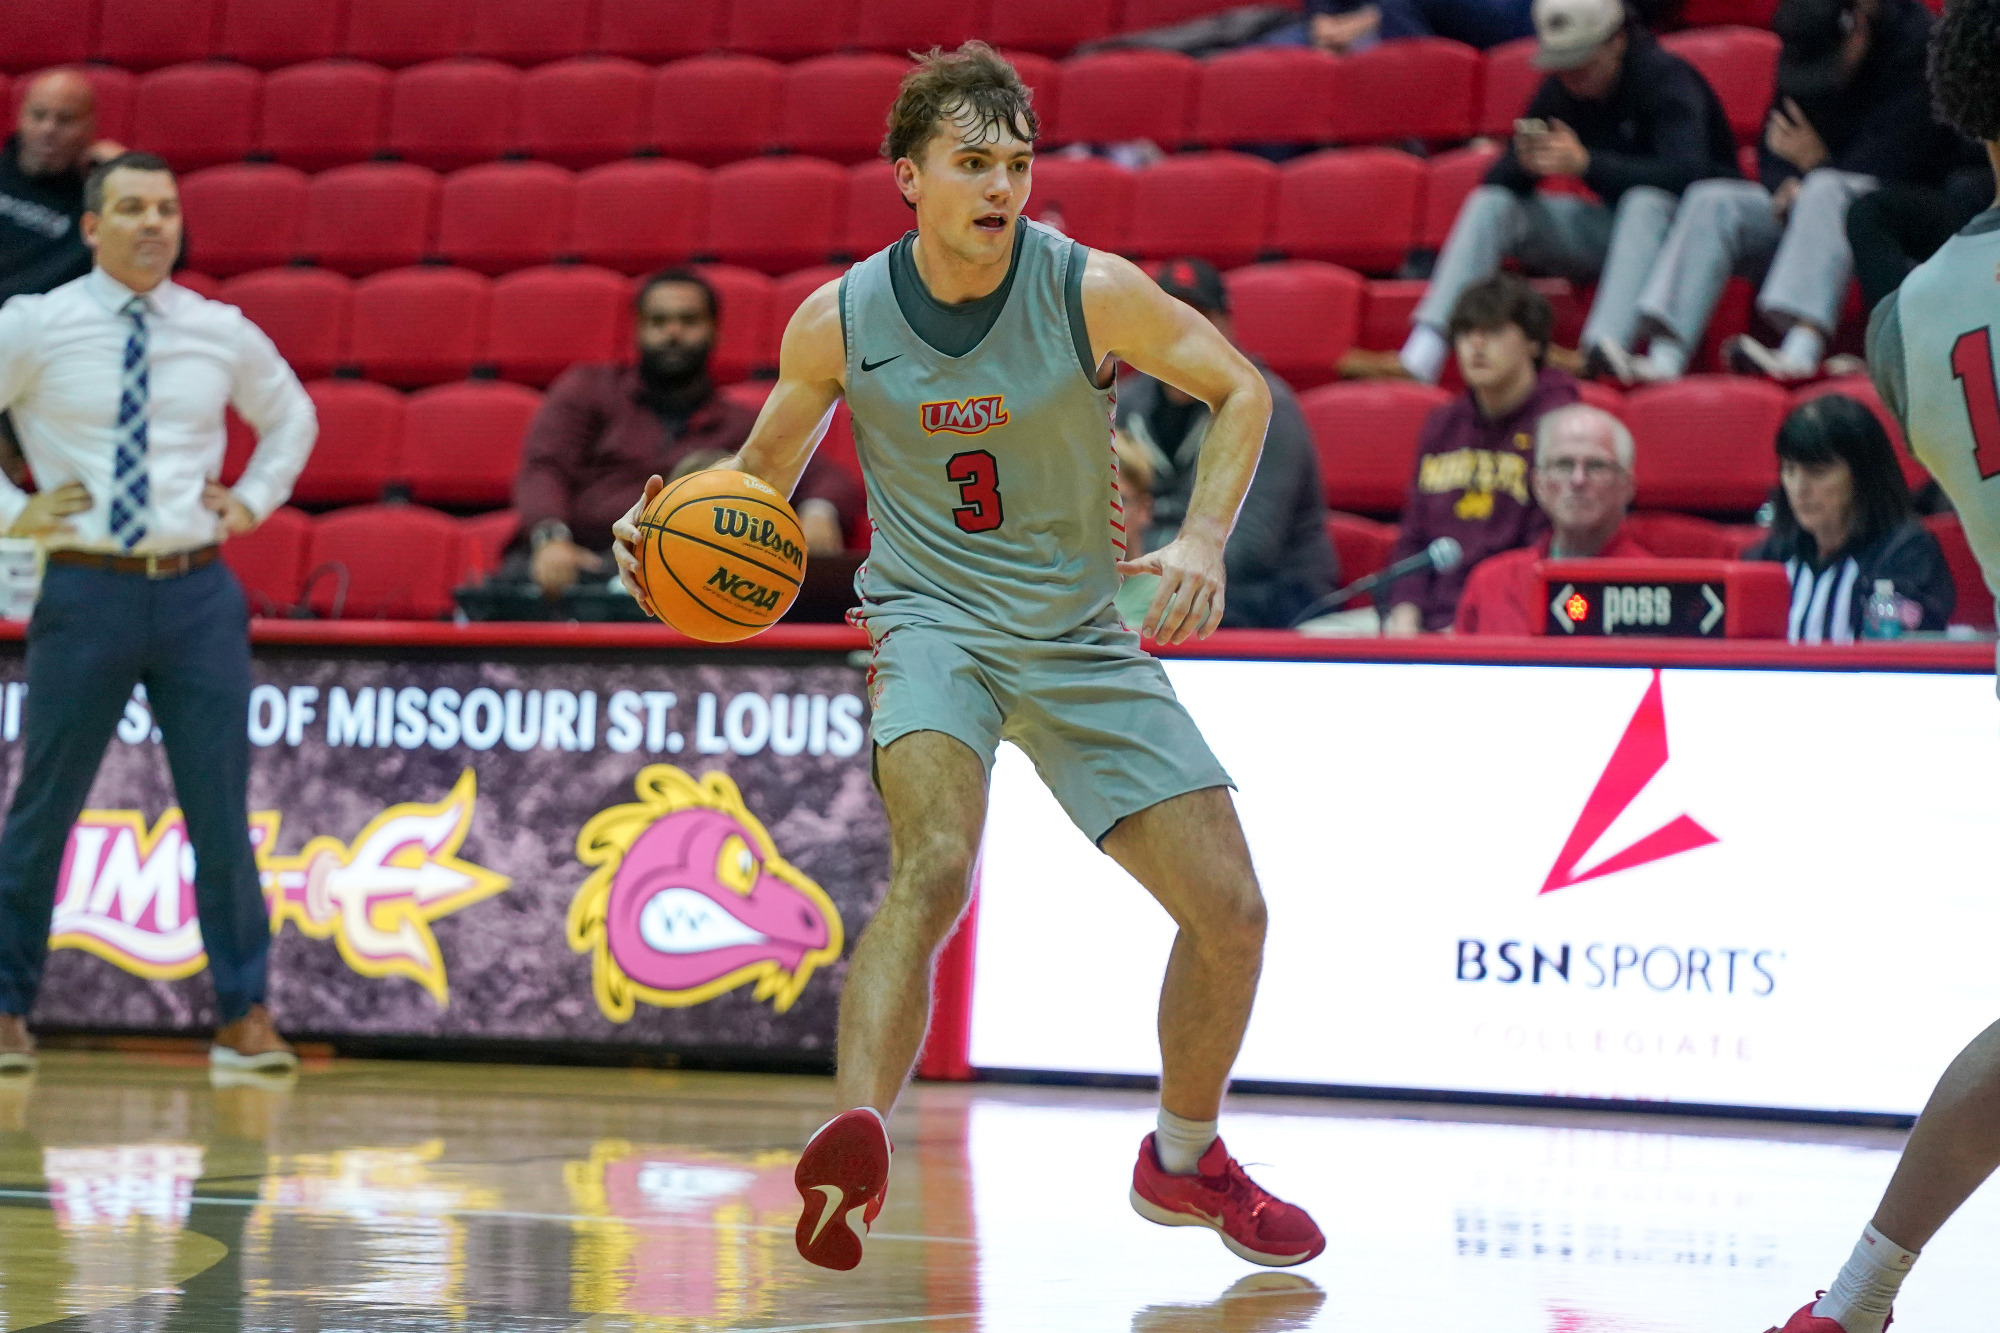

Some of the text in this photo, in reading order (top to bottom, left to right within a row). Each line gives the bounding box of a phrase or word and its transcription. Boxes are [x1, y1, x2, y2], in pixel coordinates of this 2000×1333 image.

[922, 397, 1008, 434] UMSL
[1950, 325, 2000, 481] 1
[945, 449, 1004, 534] 3
[712, 506, 803, 570] Wilson
[706, 566, 782, 612] NCAA
[247, 684, 864, 757] OF MISSOURI ST. LOUIS
